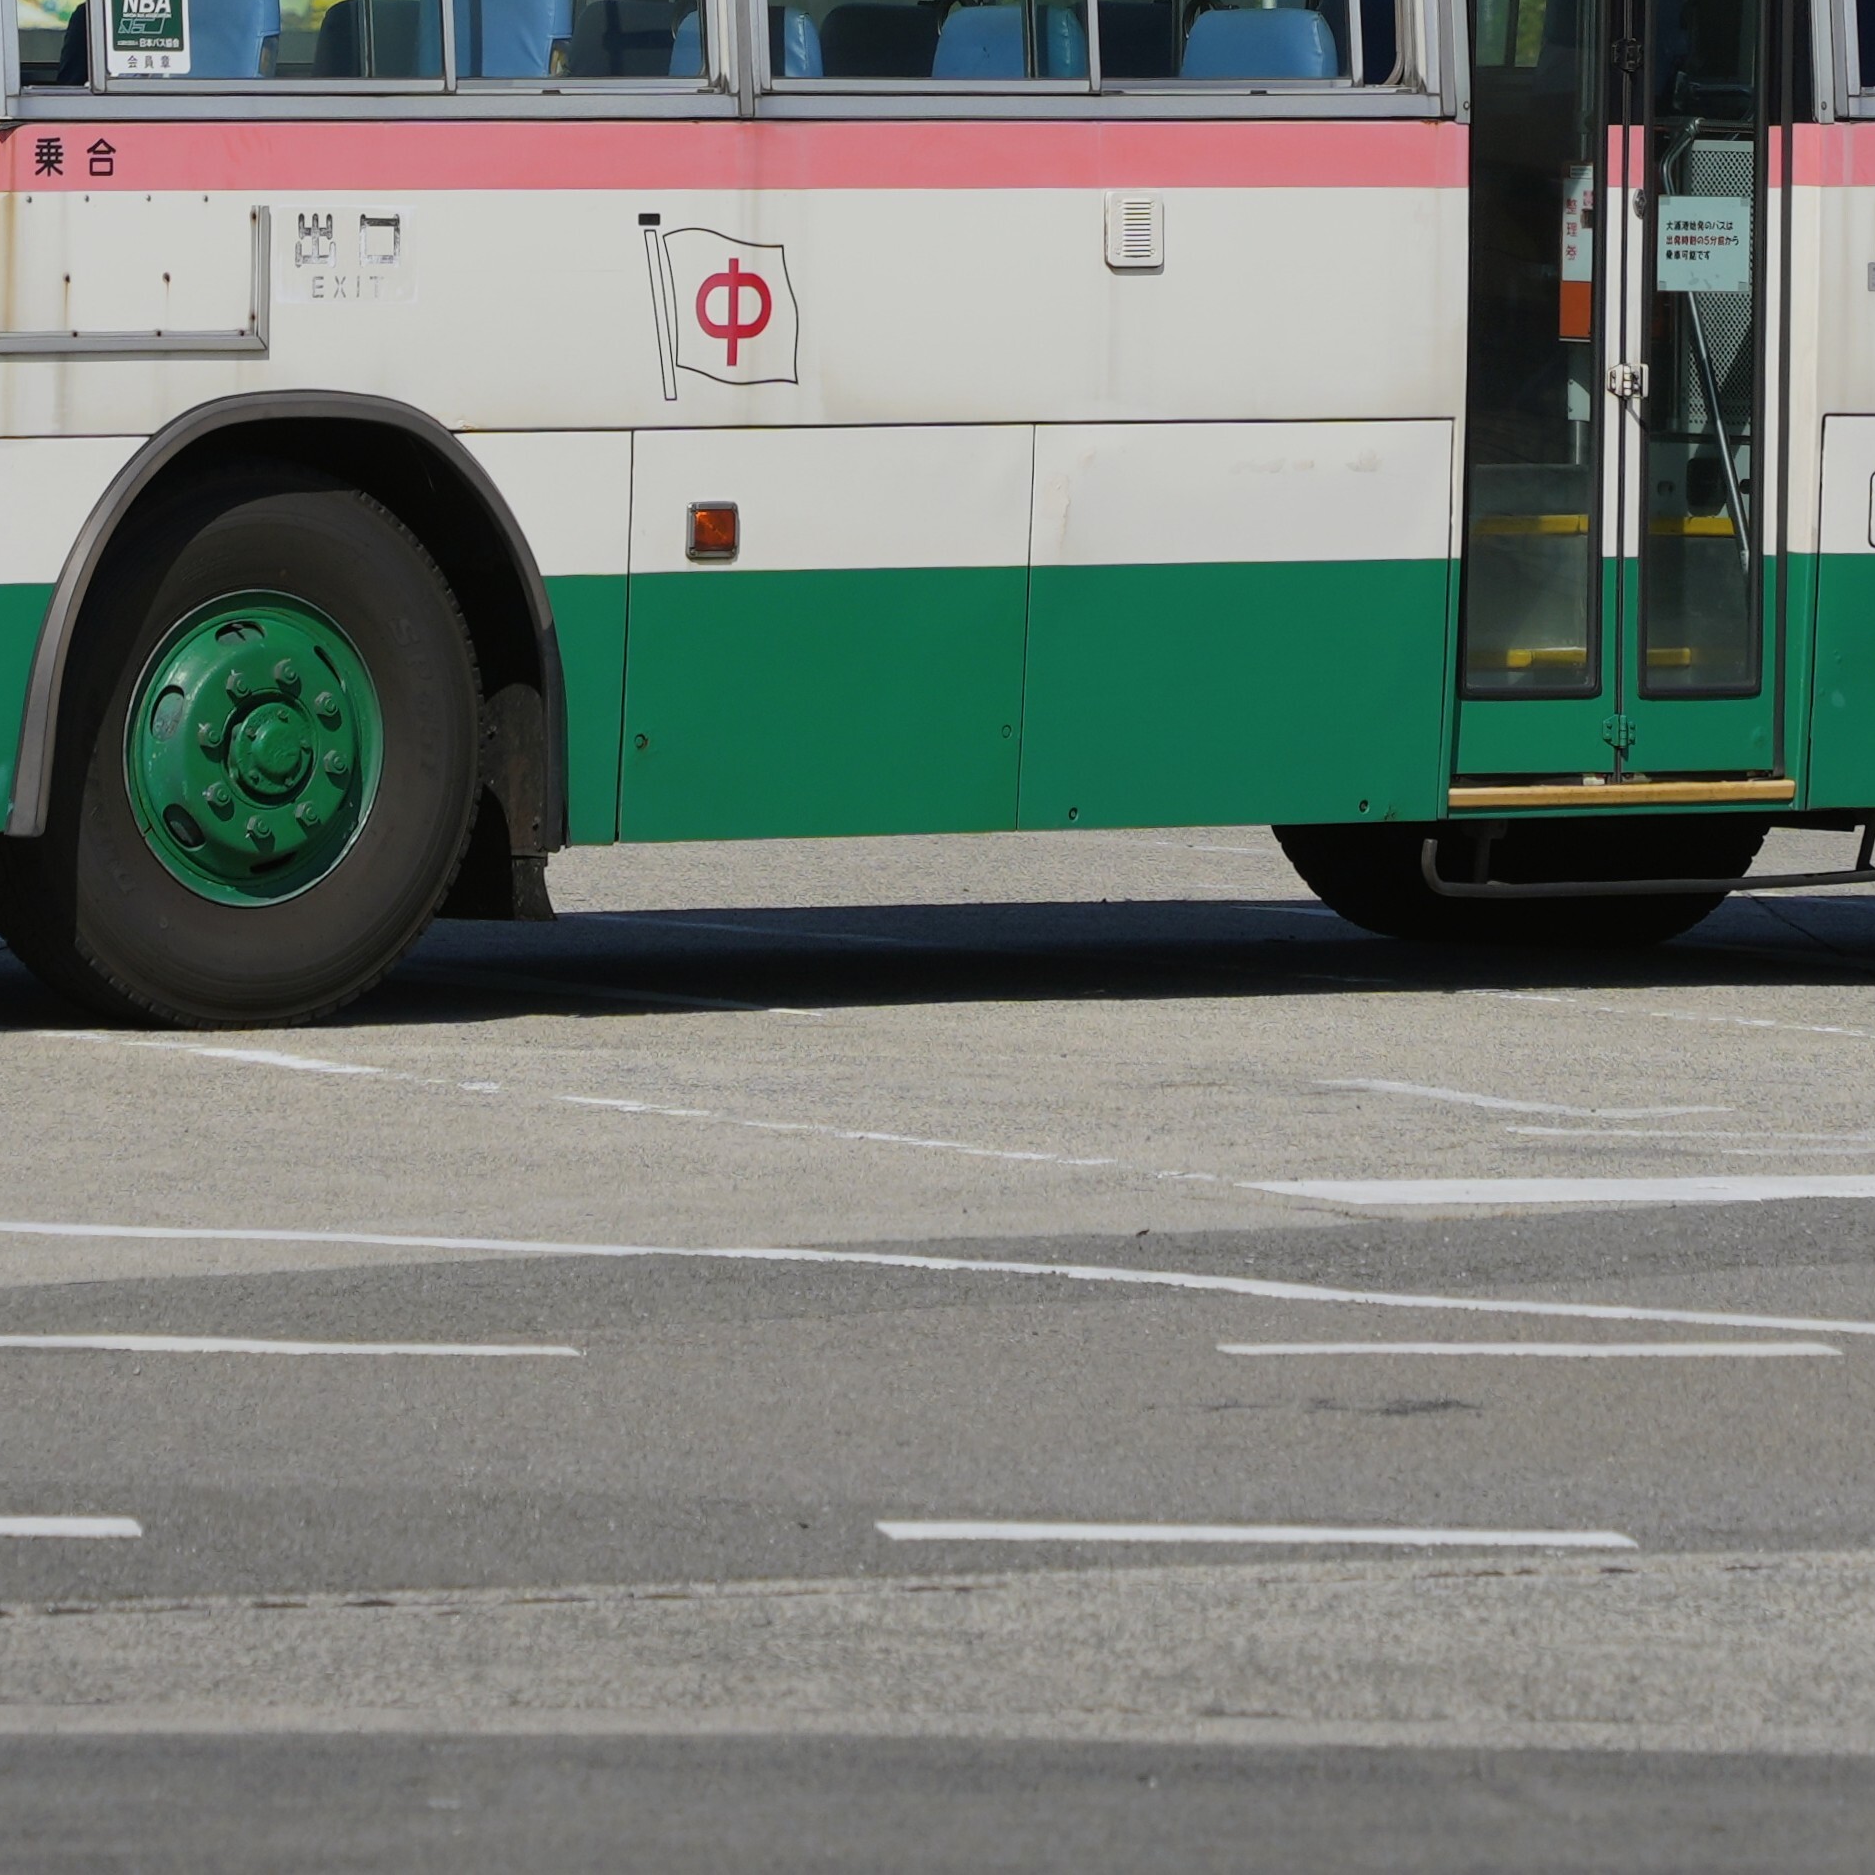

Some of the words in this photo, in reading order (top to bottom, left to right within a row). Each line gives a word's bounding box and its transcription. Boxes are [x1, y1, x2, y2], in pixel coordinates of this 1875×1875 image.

[127, 55, 171, 69] 会員章
[34, 137, 117, 177] 乗合
[294, 213, 401, 268] 出口
[311, 275, 385, 299] EXIT
